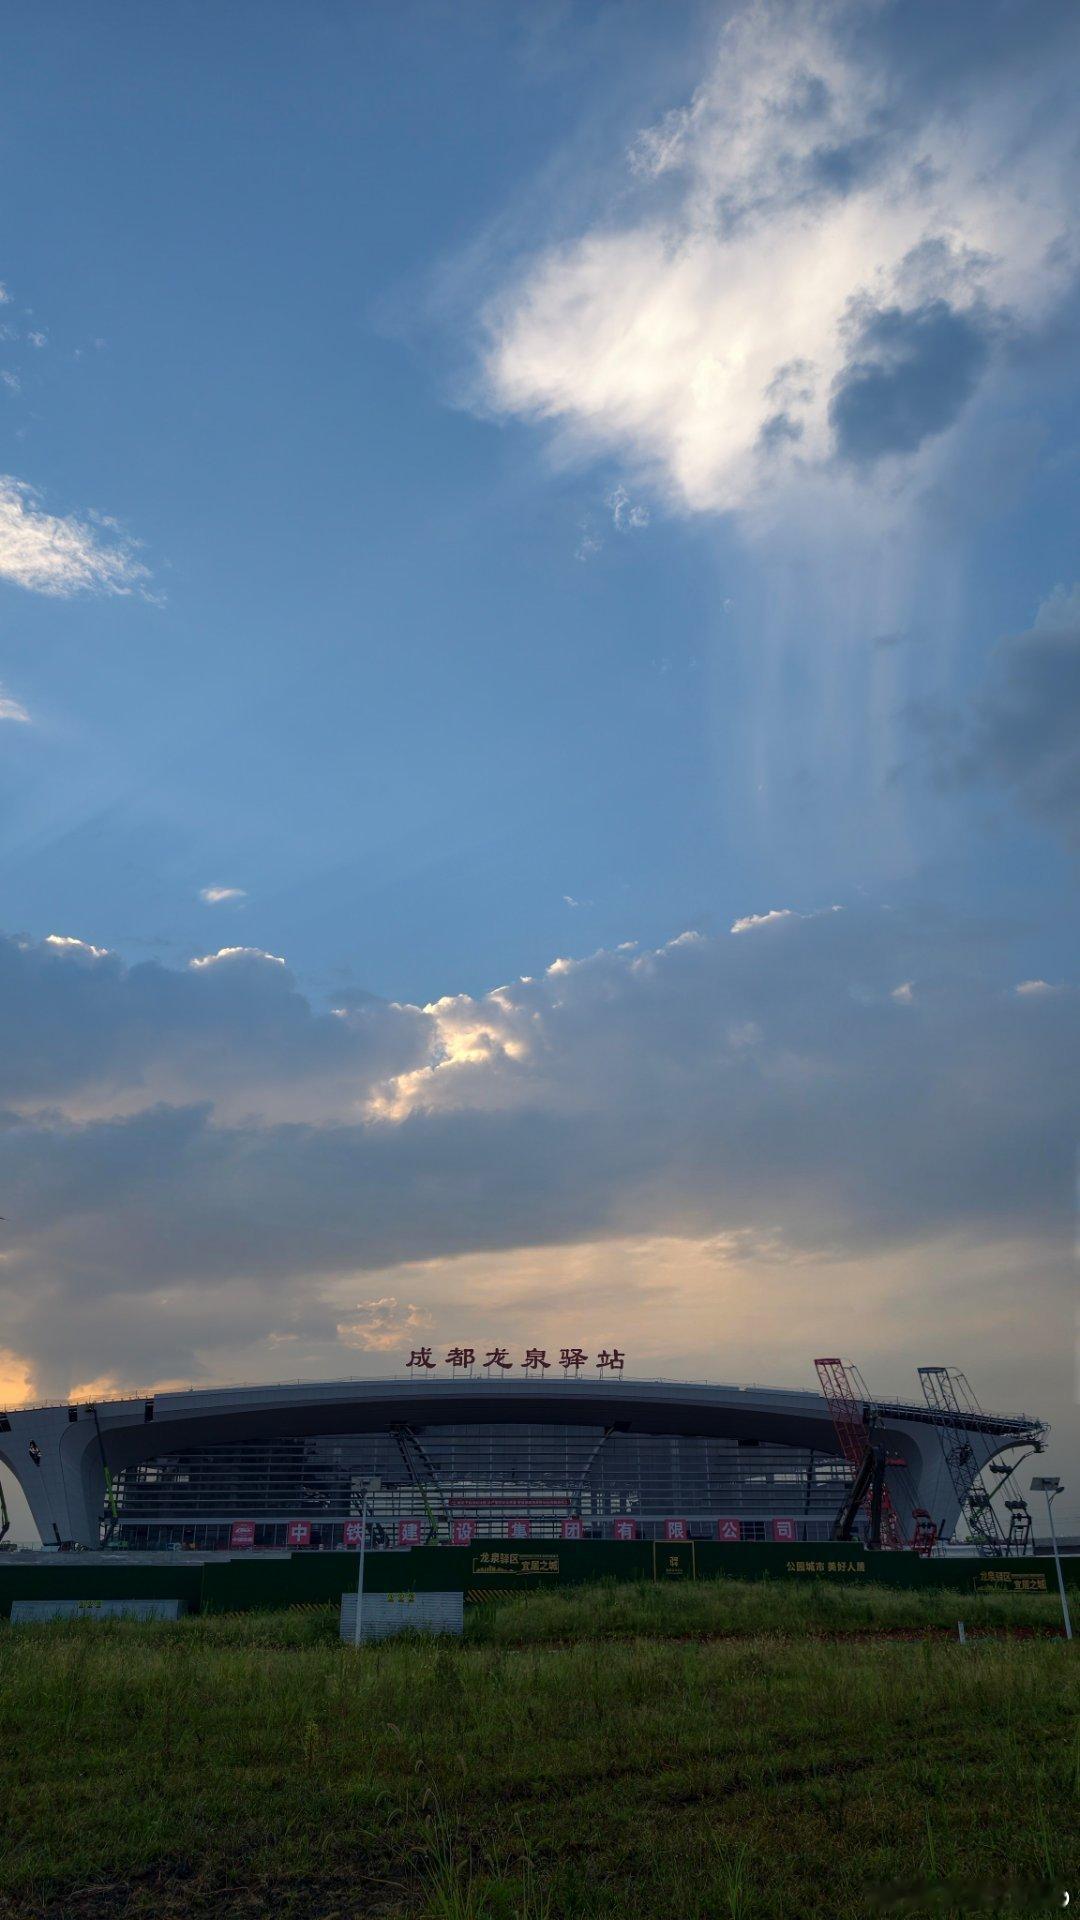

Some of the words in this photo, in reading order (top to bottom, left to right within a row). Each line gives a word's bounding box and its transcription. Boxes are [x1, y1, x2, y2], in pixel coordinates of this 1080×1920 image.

[406, 1347, 626, 1370] 成都龙泉驿站
[291, 1521, 793, 1542] 中铁建设集团有限公司
